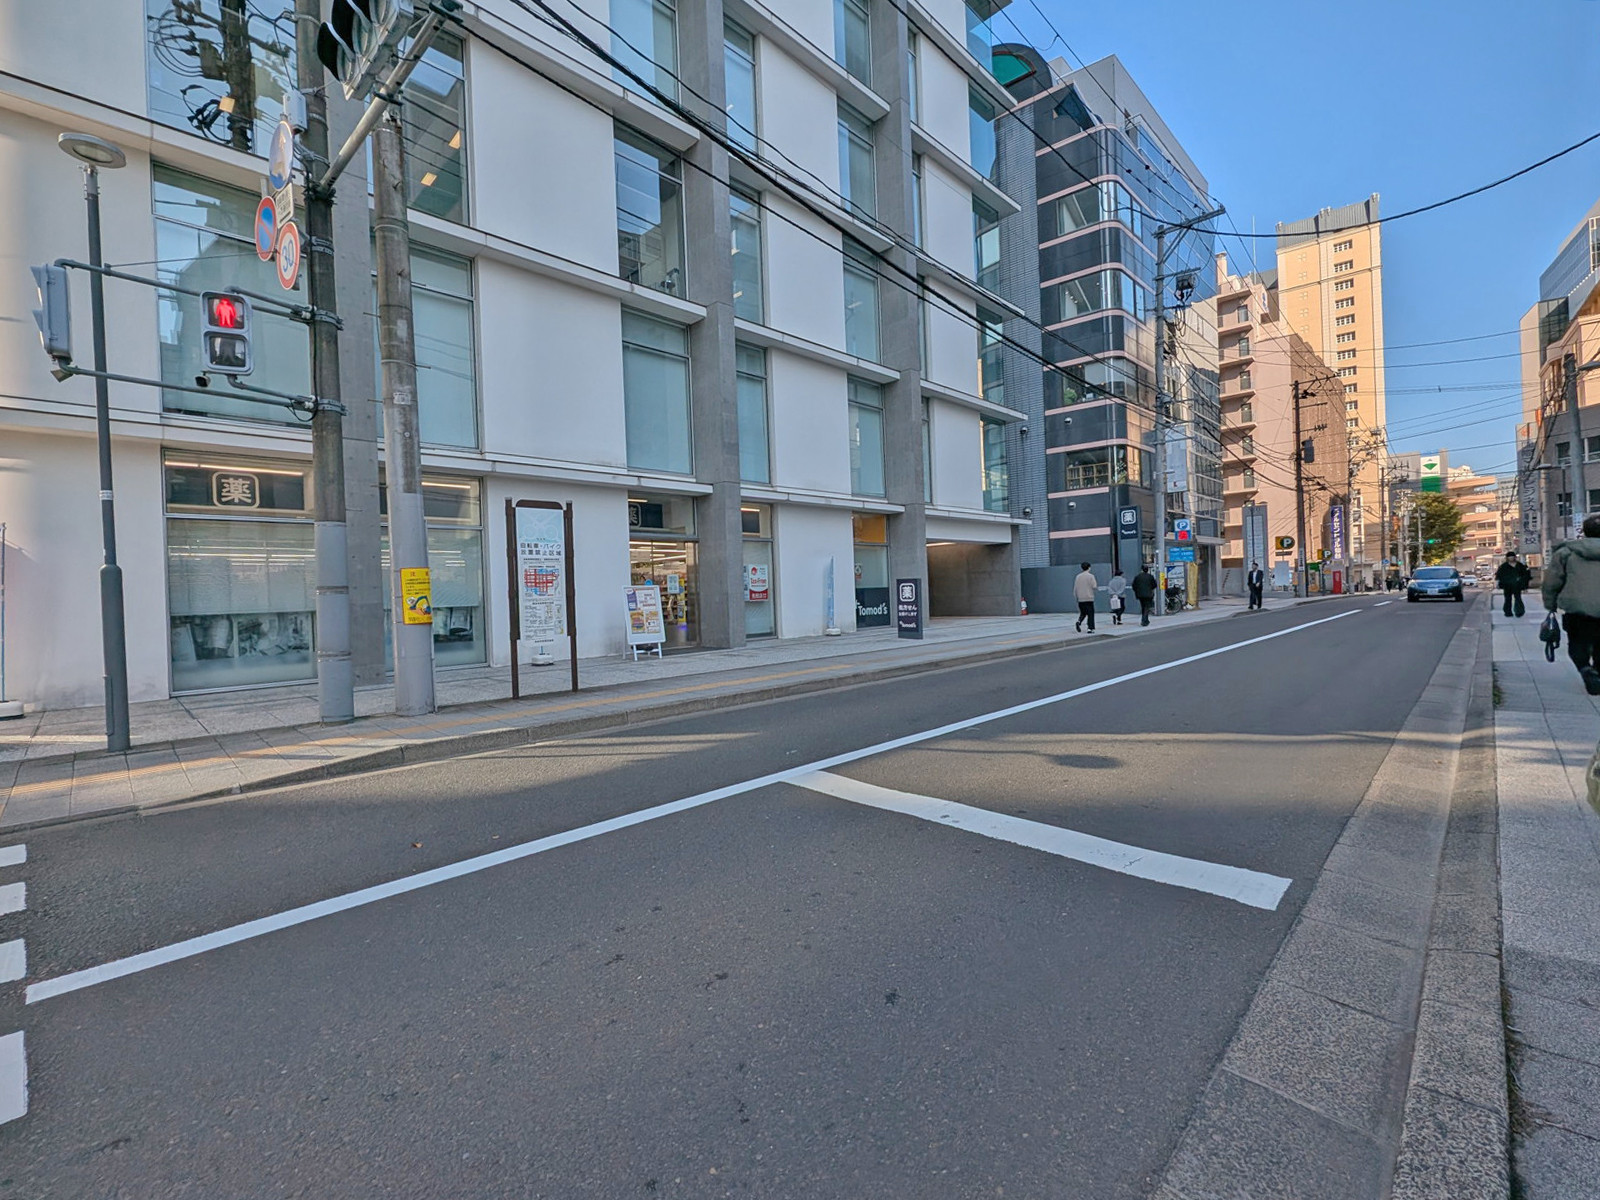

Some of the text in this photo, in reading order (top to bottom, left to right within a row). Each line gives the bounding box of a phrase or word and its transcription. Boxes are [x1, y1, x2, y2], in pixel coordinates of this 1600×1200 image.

[282, 239, 294, 272] 30
[220, 477, 252, 503] 薬
[1283, 538, 1292, 547] P
[1324, 550, 1332, 558] P
[902, 585, 913, 599] 薬
[858, 602, 888, 616] Tomod's
